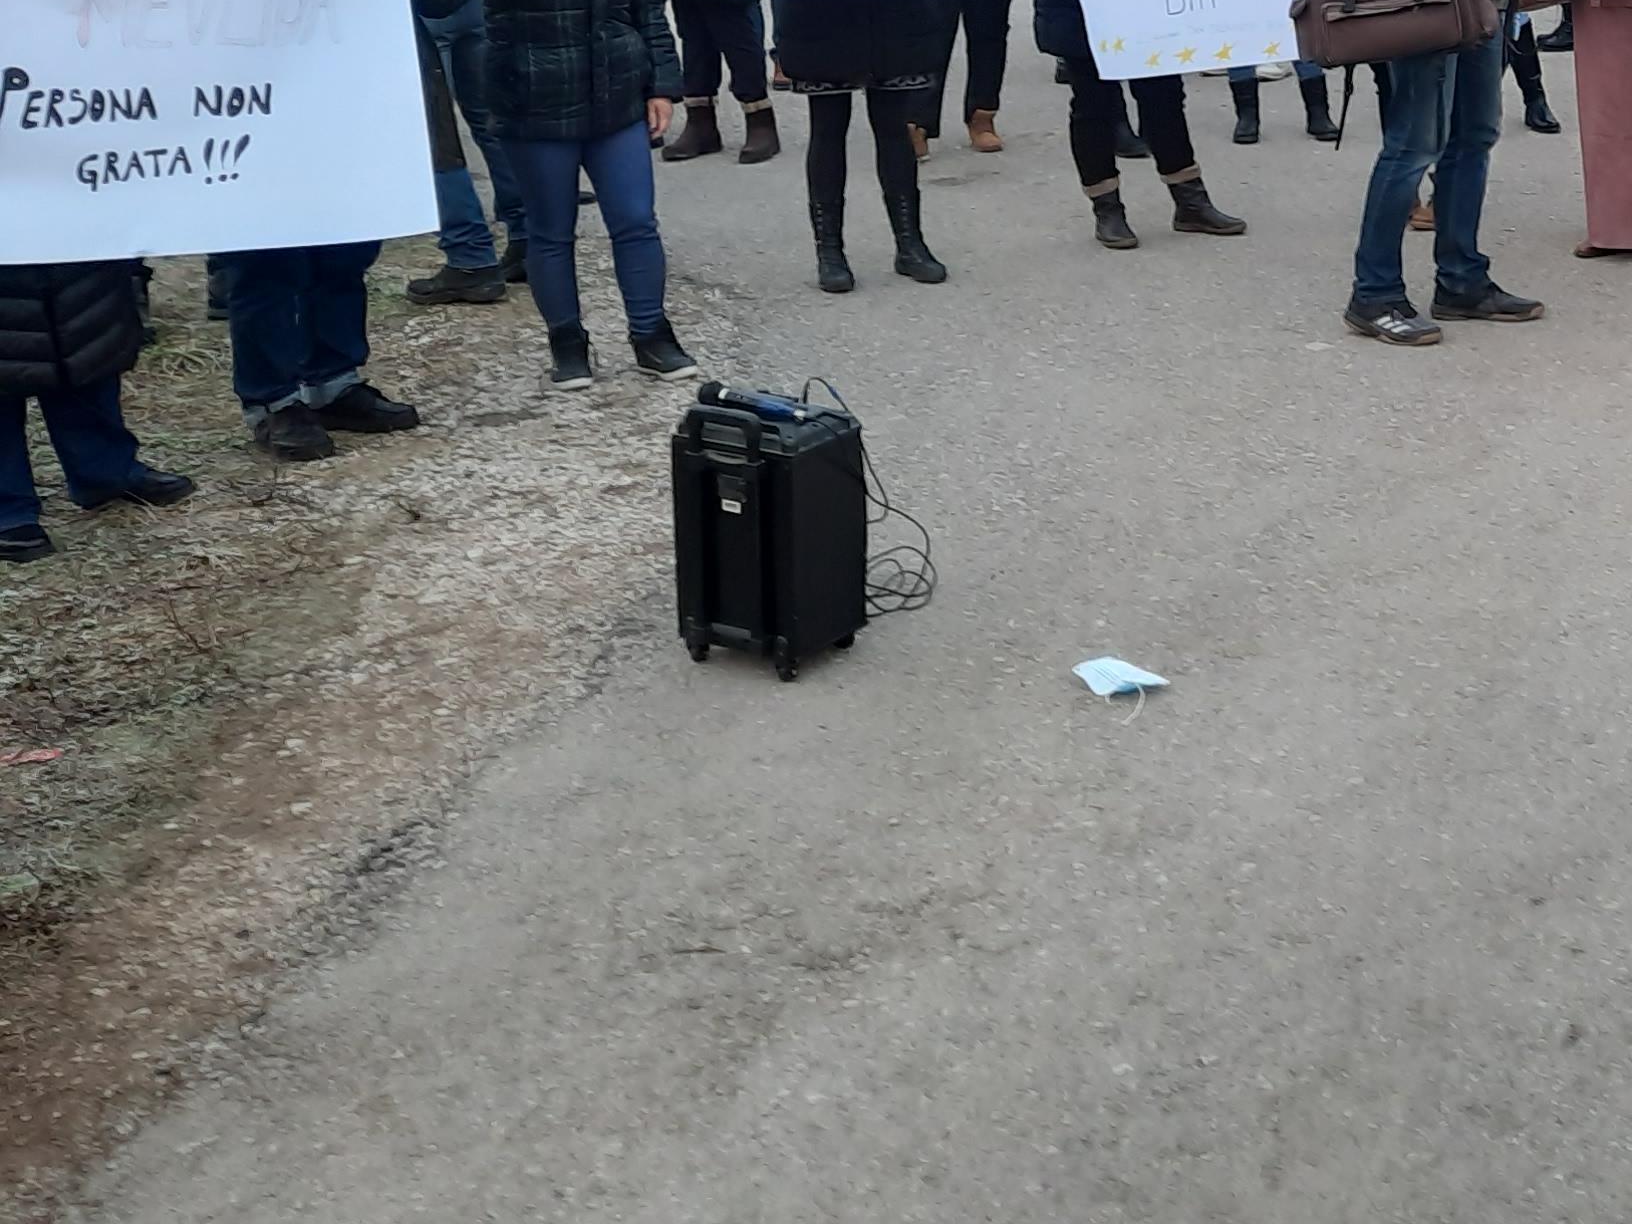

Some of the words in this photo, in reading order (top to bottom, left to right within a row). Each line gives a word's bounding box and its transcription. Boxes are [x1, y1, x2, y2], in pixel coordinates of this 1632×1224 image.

[0, 66, 158, 130] PERSONA
[193, 82, 272, 117] NON
[76, 133, 251, 193] GRATA!!!
